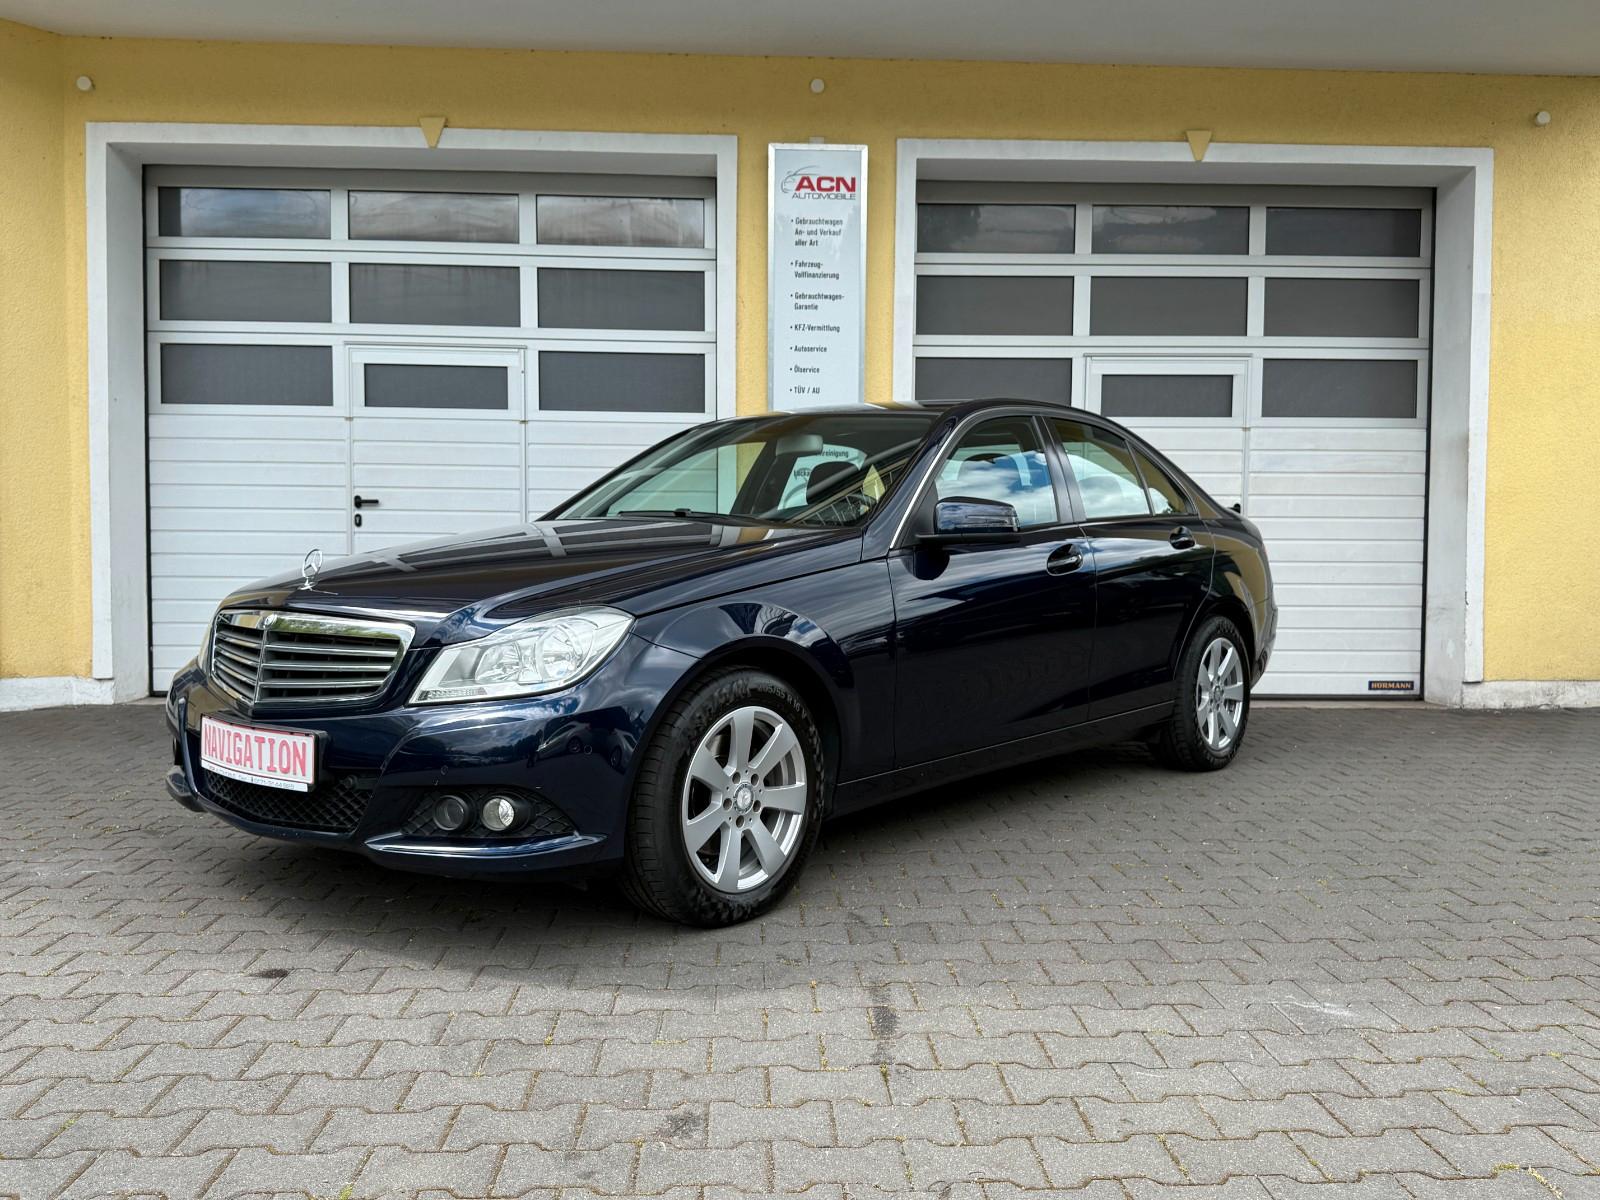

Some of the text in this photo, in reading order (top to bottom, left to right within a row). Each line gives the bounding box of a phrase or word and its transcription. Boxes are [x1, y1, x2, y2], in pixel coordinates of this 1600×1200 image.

[795, 175, 856, 192] ACN
[792, 192, 856, 200] AUTOMOBILE
[795, 217, 843, 226] Gebrauchtwagen
[807, 228, 817, 236] und
[819, 228, 841, 236] Verkauf
[794, 260, 823, 269] Fahrzeug-
[794, 271, 840, 280] Vollfinanzierung
[794, 292, 845, 301] Gebrauchtwagen-
[794, 323, 840, 333] KFZ-Vermittlung
[793, 364, 820, 373] Ölservice
[794, 386, 806, 394] TÜV
[204, 723, 306, 777] NAVIGATION
